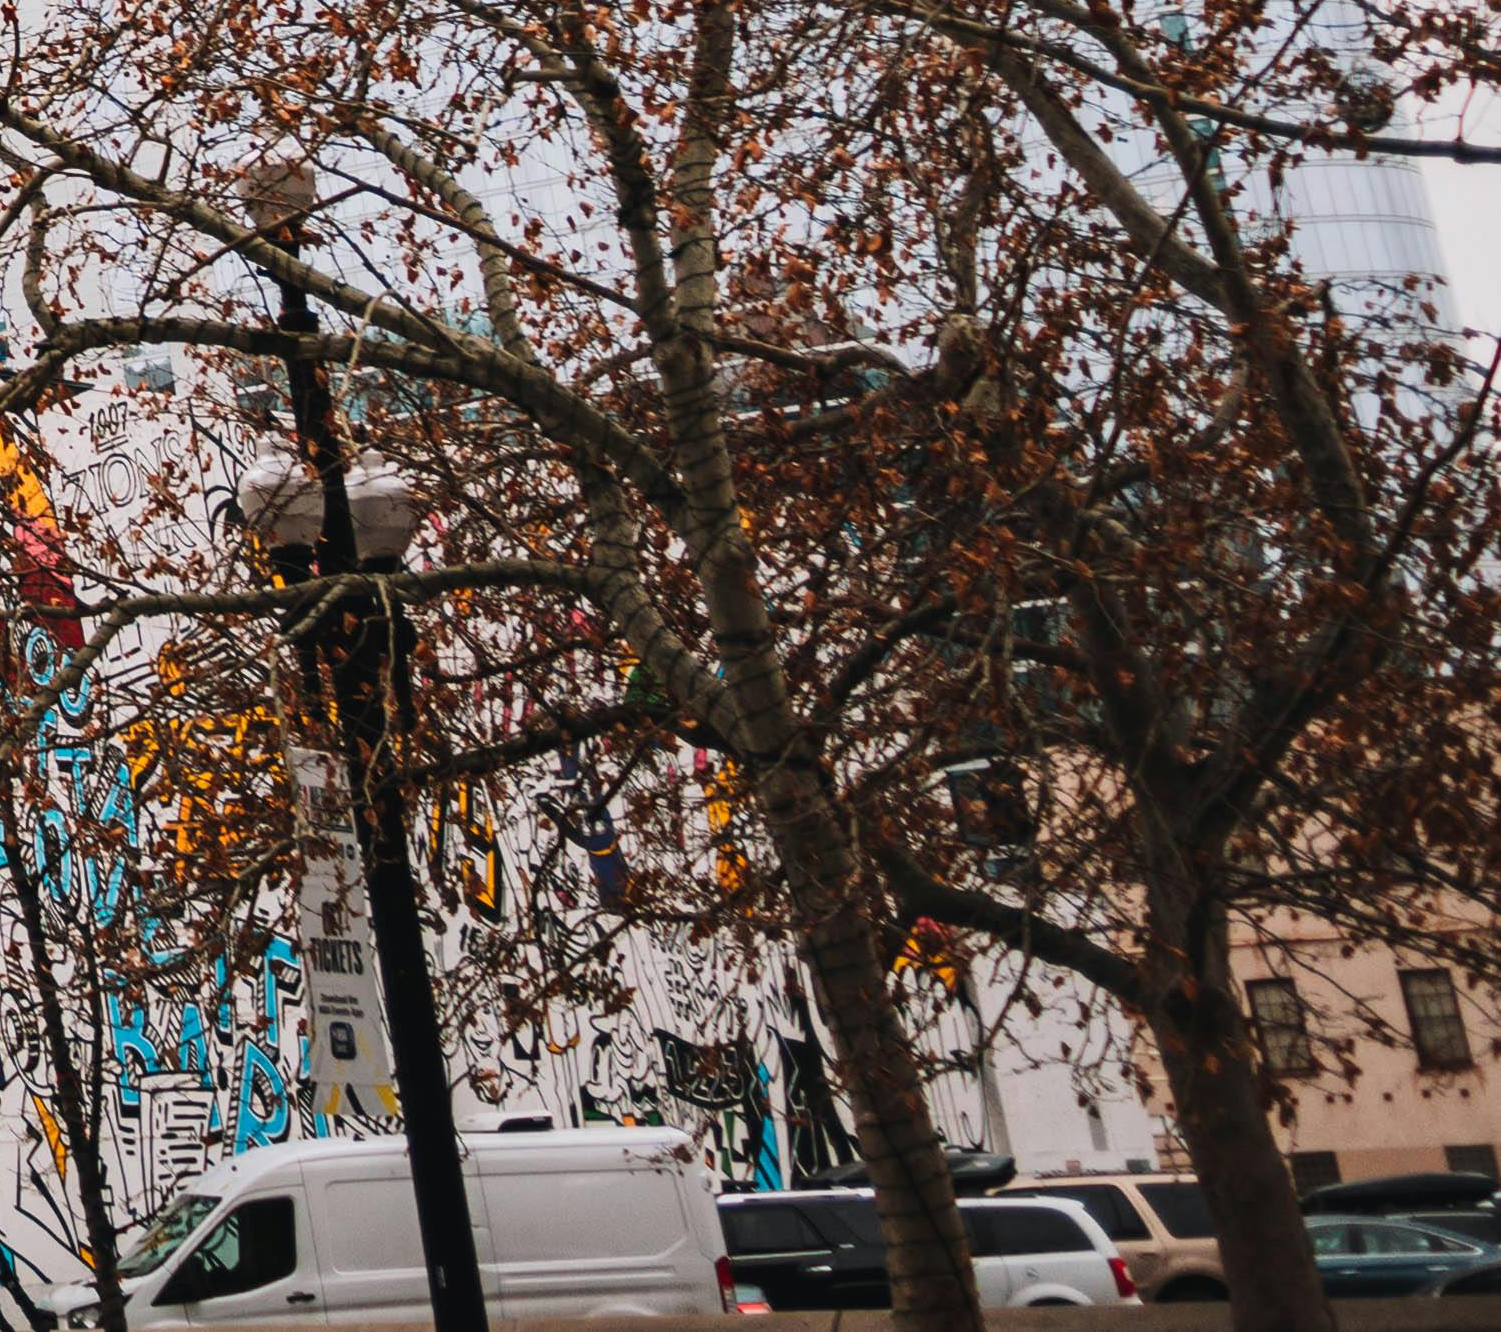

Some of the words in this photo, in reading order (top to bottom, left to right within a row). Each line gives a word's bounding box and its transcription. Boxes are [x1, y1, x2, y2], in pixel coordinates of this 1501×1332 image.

[61, 429, 184, 515] ZIONS
[65, 509, 196, 591] BNK
[310, 937, 364, 975] TICKETS
